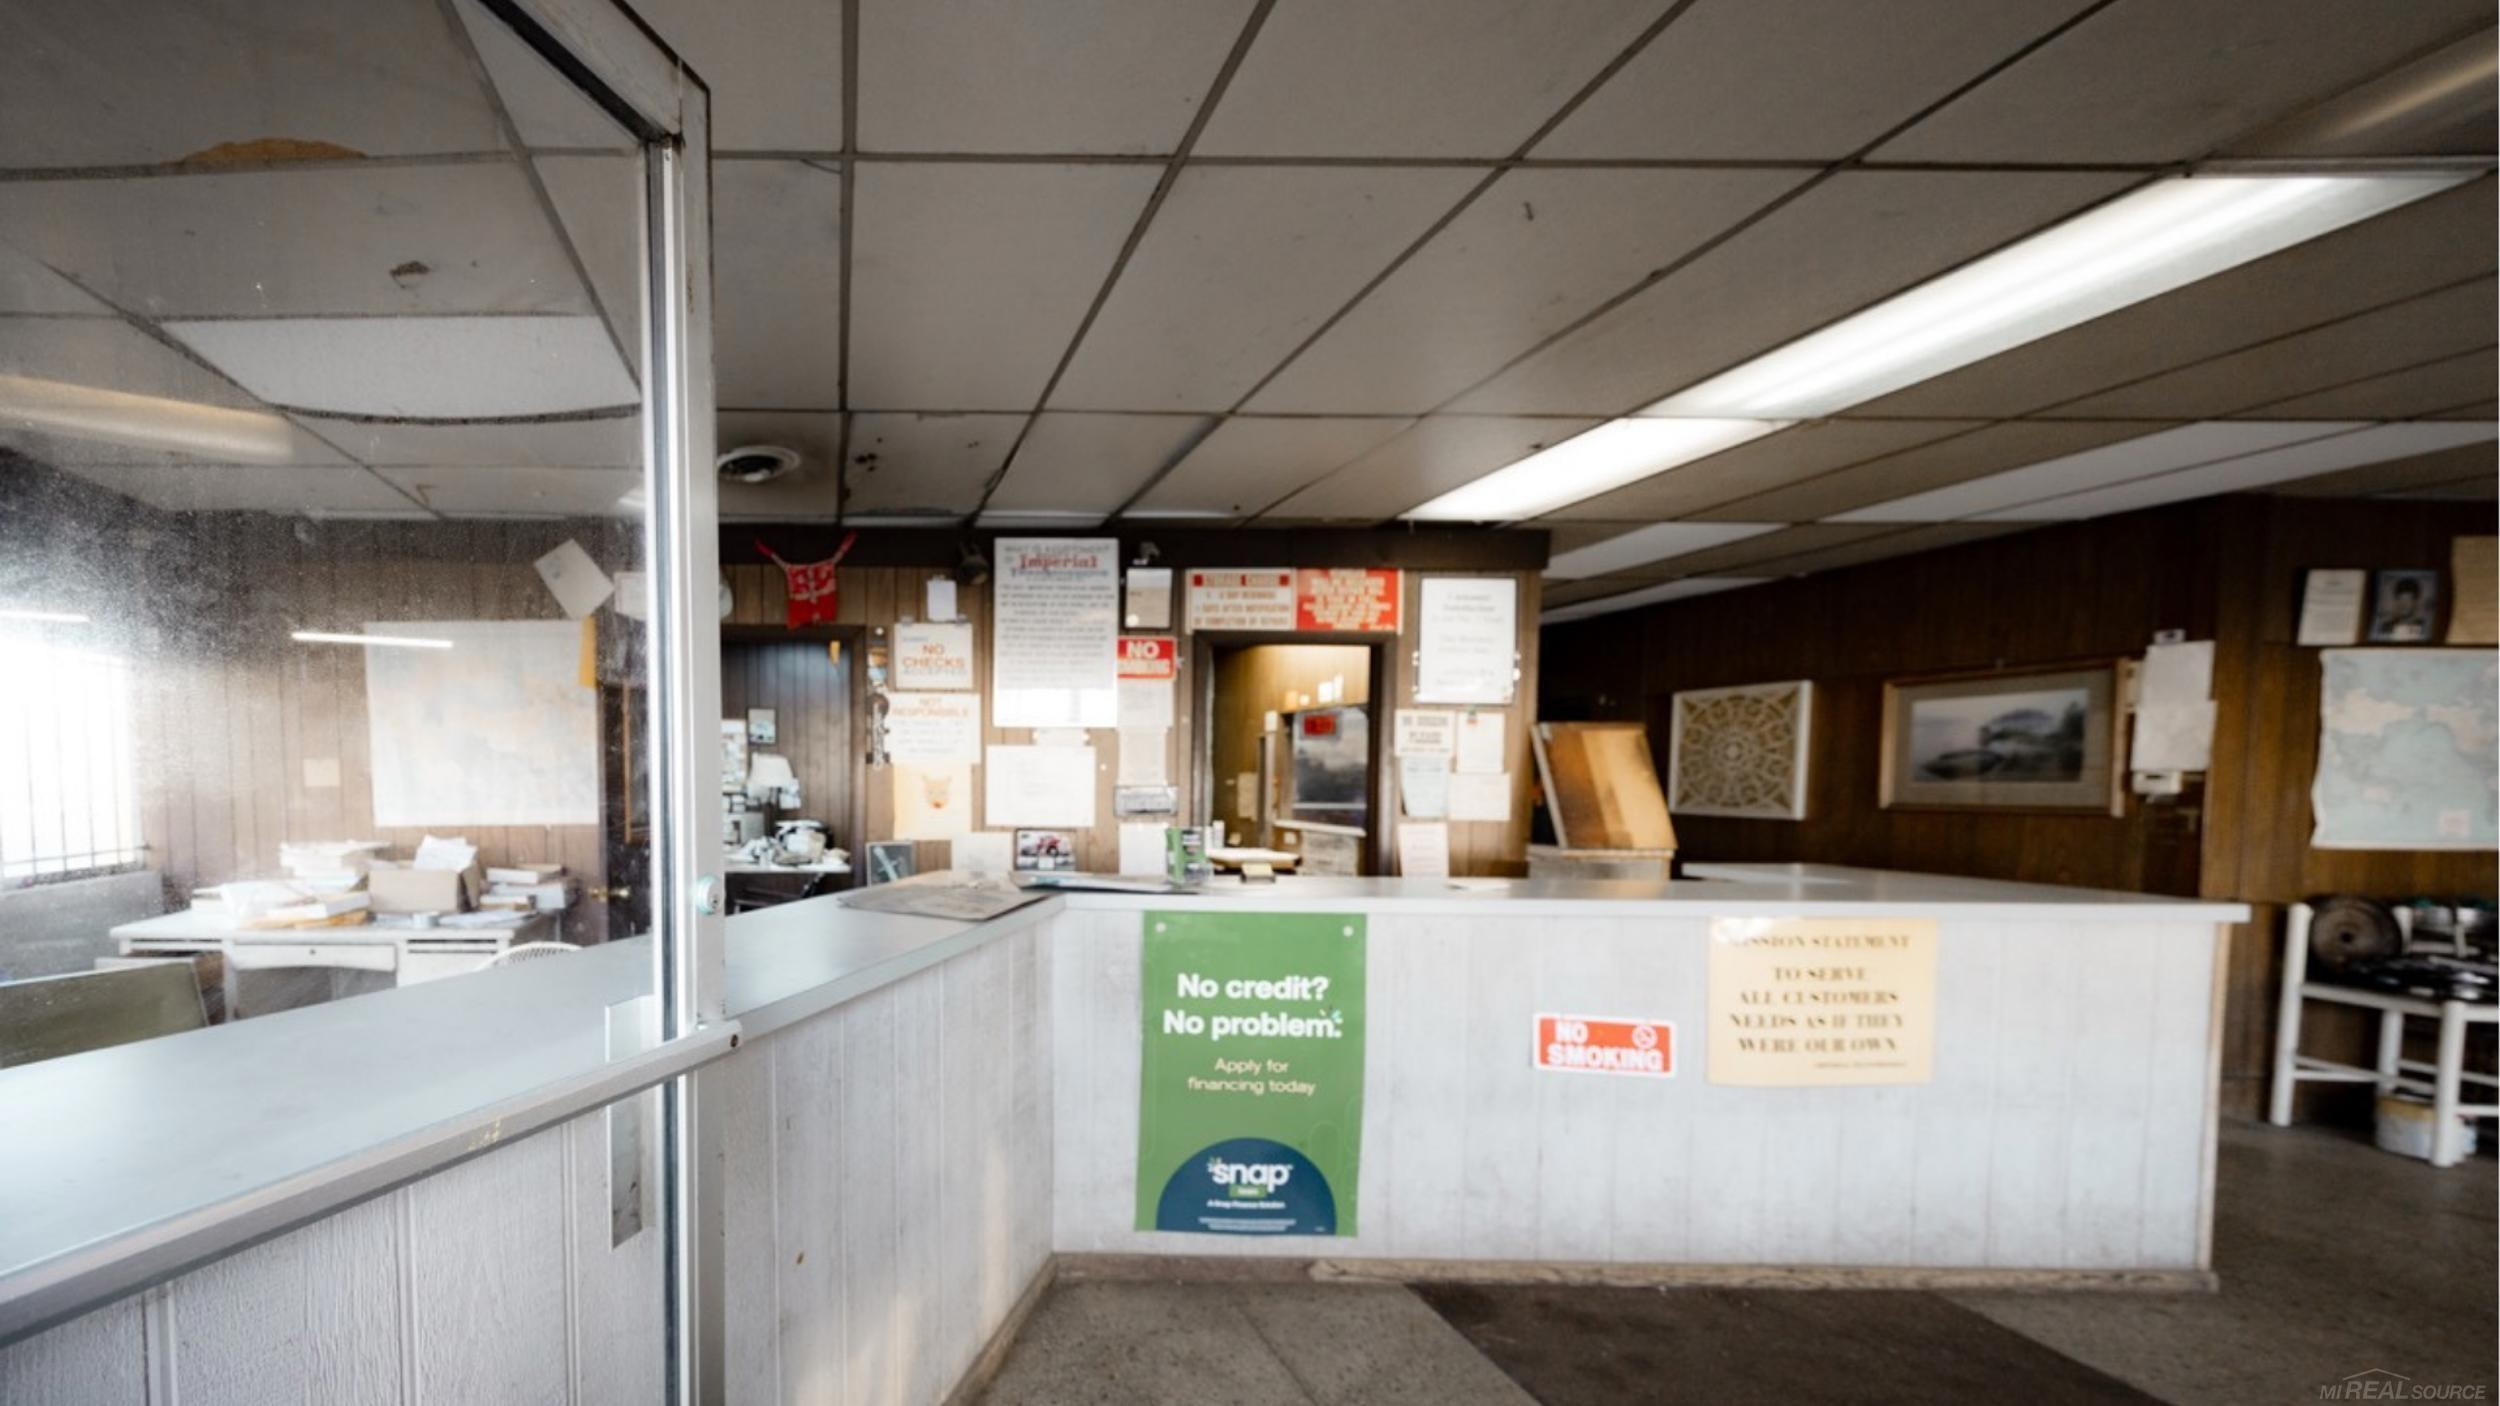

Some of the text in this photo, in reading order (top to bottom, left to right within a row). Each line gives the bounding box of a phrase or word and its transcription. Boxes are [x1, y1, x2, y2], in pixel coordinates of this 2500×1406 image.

[1021, 553, 1098, 572] Imperial
[922, 644, 944, 655] NO
[1127, 640, 1160, 659] NO
[902, 657, 965, 668] CHECKS
[1731, 935, 1910, 948] ISSION STATEMENT
[1775, 967, 1865, 981] TO SERVE
[1177, 973, 1330, 1001] No credit?
[1740, 991, 1899, 1004] ALL CUSTOMERS
[1163, 1009, 1205, 1034] No
[1730, 1014, 1904, 1029] NEEDS AS IF THEY
[1555, 1020, 1589, 1044] NO
[1737, 1038, 1796, 1052] WERE
[1804, 1038, 1846, 1052] OUR
[1214, 1057, 1289, 1075] Apply for
[1547, 1043, 1664, 1073] SMOKING
[1188, 1076, 1316, 1096] financing today
[1211, 1162, 1290, 1193] snap
